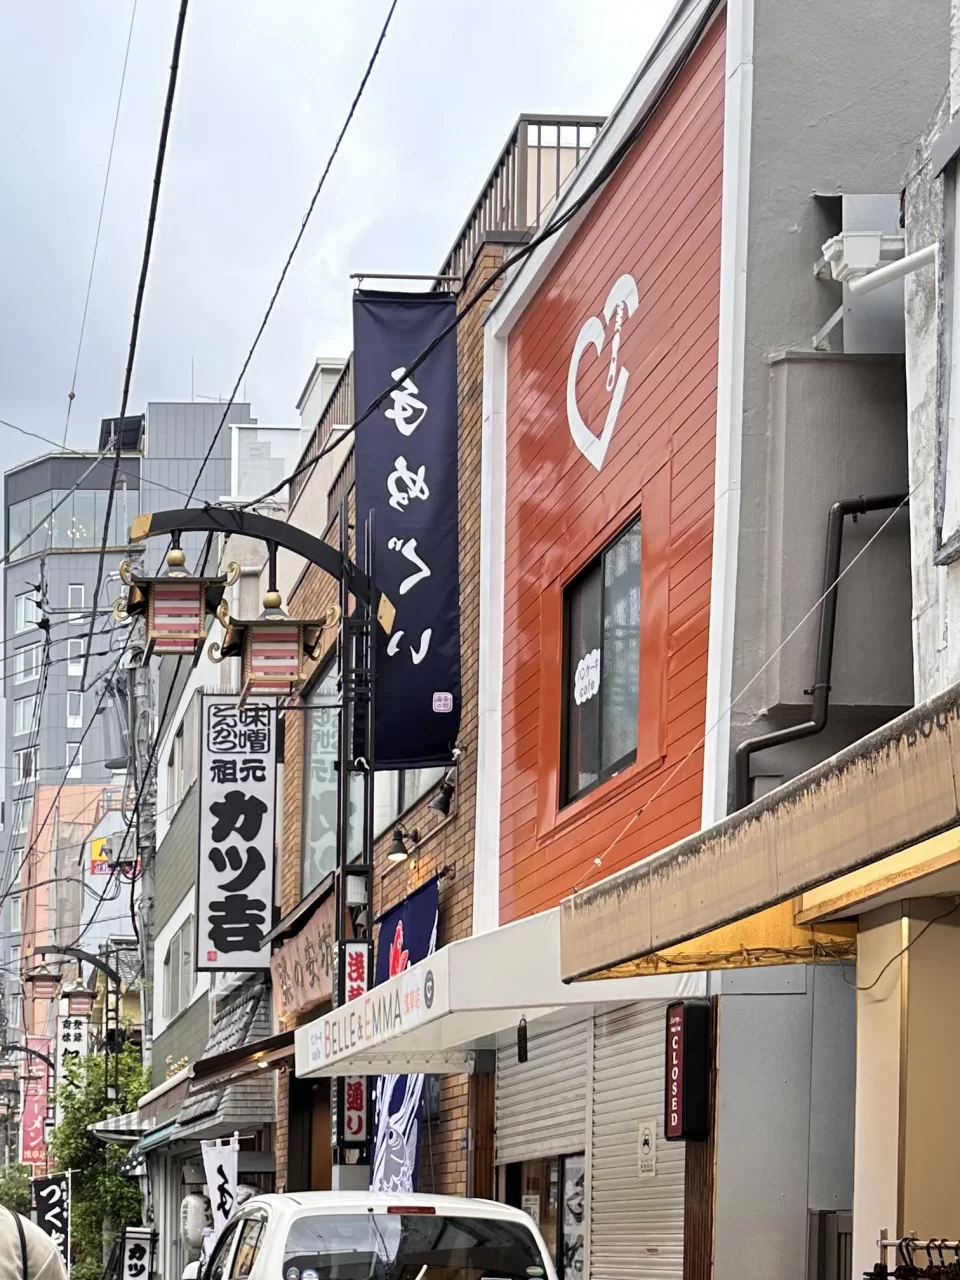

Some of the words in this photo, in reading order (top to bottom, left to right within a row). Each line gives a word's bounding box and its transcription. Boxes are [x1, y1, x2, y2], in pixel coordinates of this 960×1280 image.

[208, 790, 268, 953] カツ吉
[325, 1012, 356, 1058] BELLE
[364, 988, 402, 1040] EMMA
[671, 1035, 679, 1126] CLOSED
